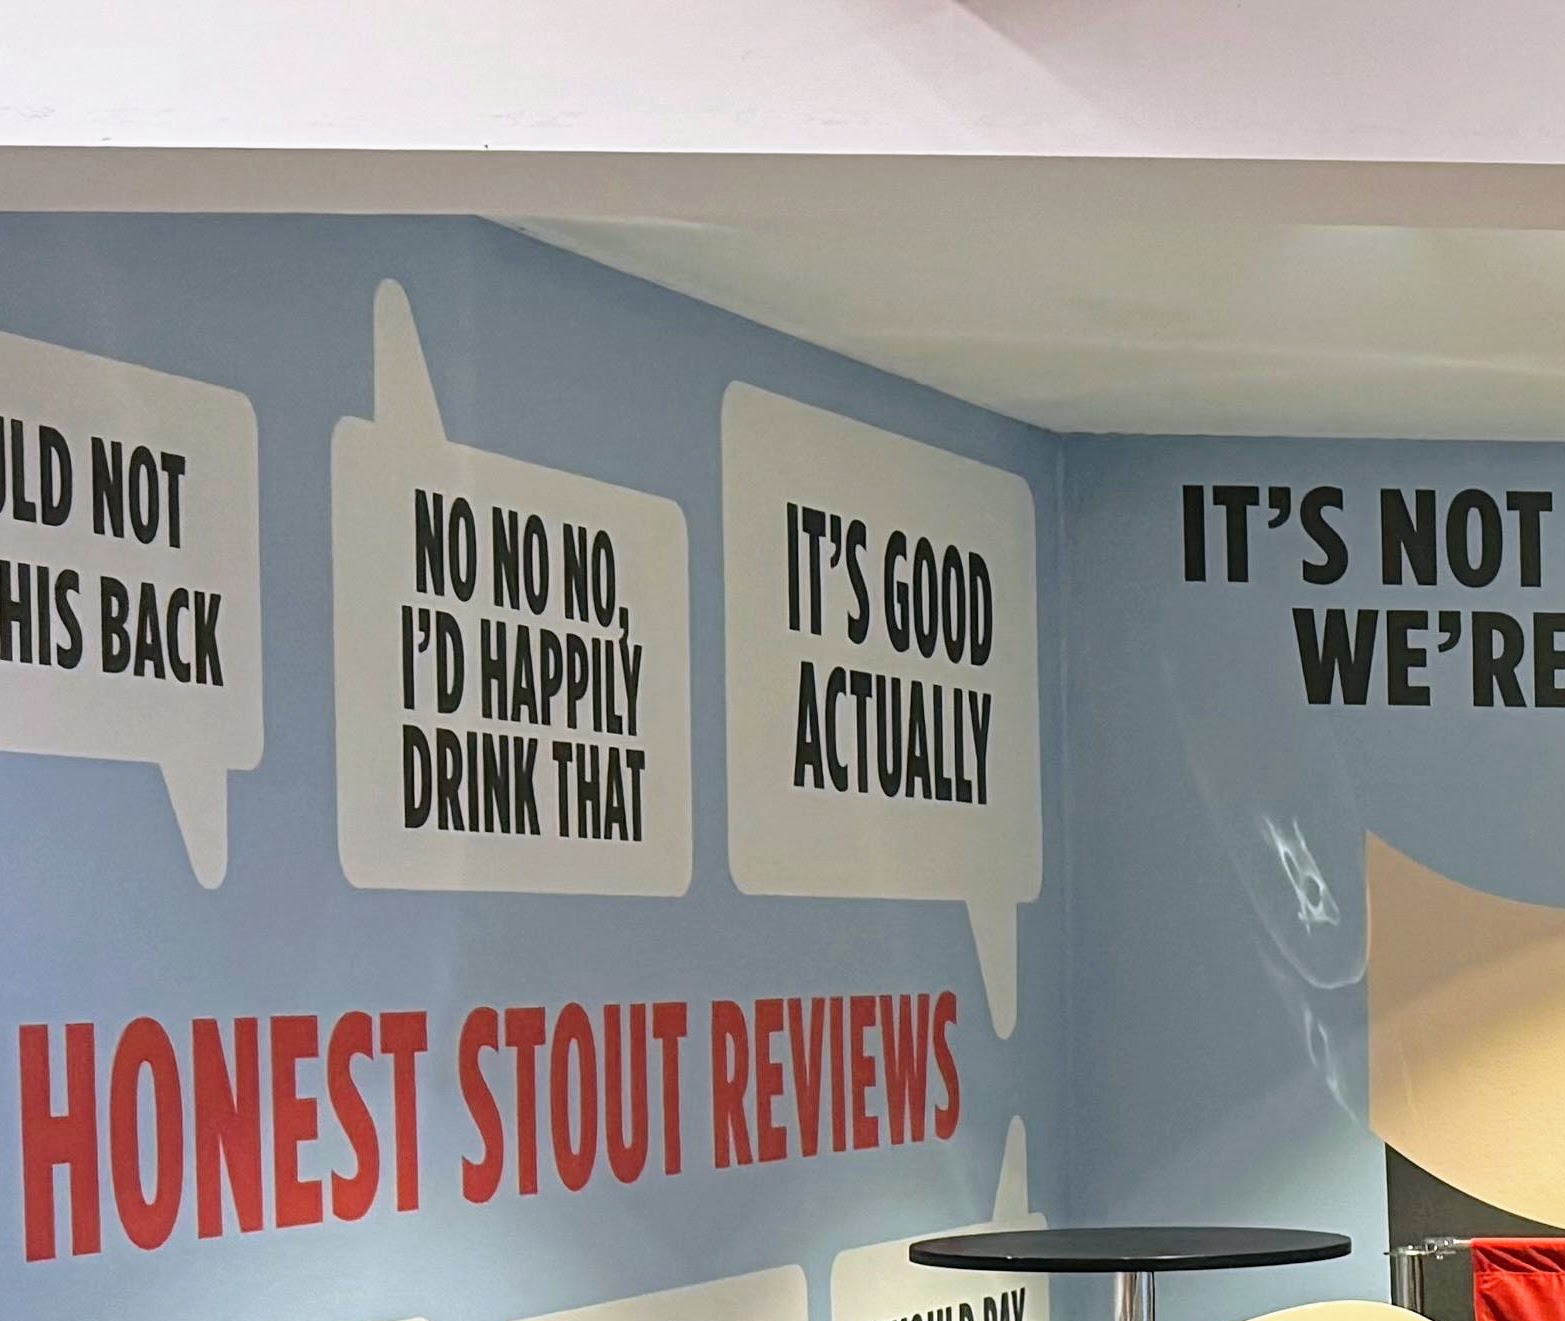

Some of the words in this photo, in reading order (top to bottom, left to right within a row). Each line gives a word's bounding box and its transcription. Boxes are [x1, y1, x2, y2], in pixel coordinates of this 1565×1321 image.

[91, 436, 185, 548] NOT
[1181, 485, 1348, 585] IT'S
[1380, 489, 1552, 588] NOT
[414, 489, 476, 602] NO
[491, 506, 548, 615] NO
[563, 523, 629, 640] NO,
[786, 501, 870, 644] IT'S
[884, 529, 992, 667] GOOD
[100, 576, 223, 686] BACK
[402, 605, 464, 716] I'D
[481, 625, 642, 737] HAPPILY
[403, 724, 540, 839] DRINK
[552, 740, 645, 843] THAT
[793, 660, 992, 806] ACTUALLY
[18, 1010, 427, 1262] HONEST
[460, 1001, 688, 1204] STOUT
[711, 990, 959, 1170] REVIEWS
